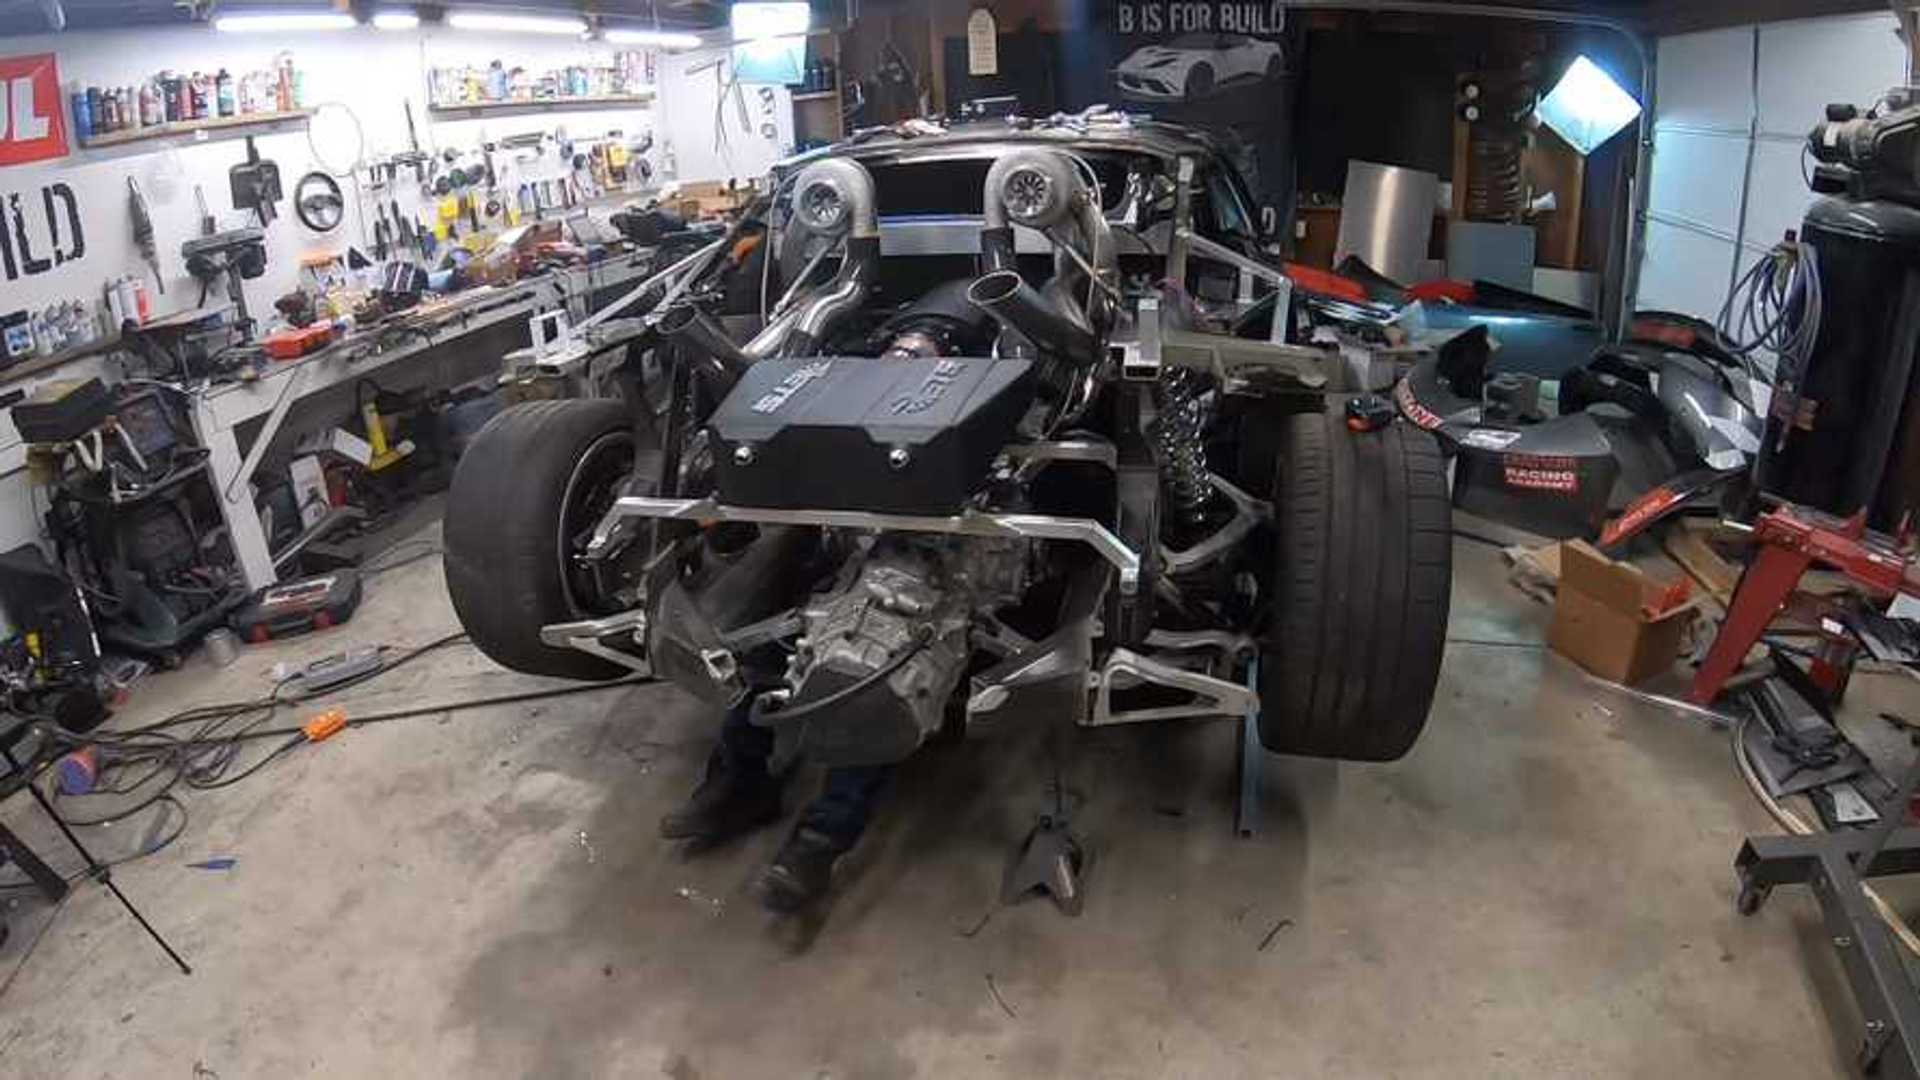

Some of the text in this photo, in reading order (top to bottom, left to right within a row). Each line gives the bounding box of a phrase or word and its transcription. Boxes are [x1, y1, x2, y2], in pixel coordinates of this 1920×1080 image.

[1118, 3, 1286, 34] B IS FOR BUILD
